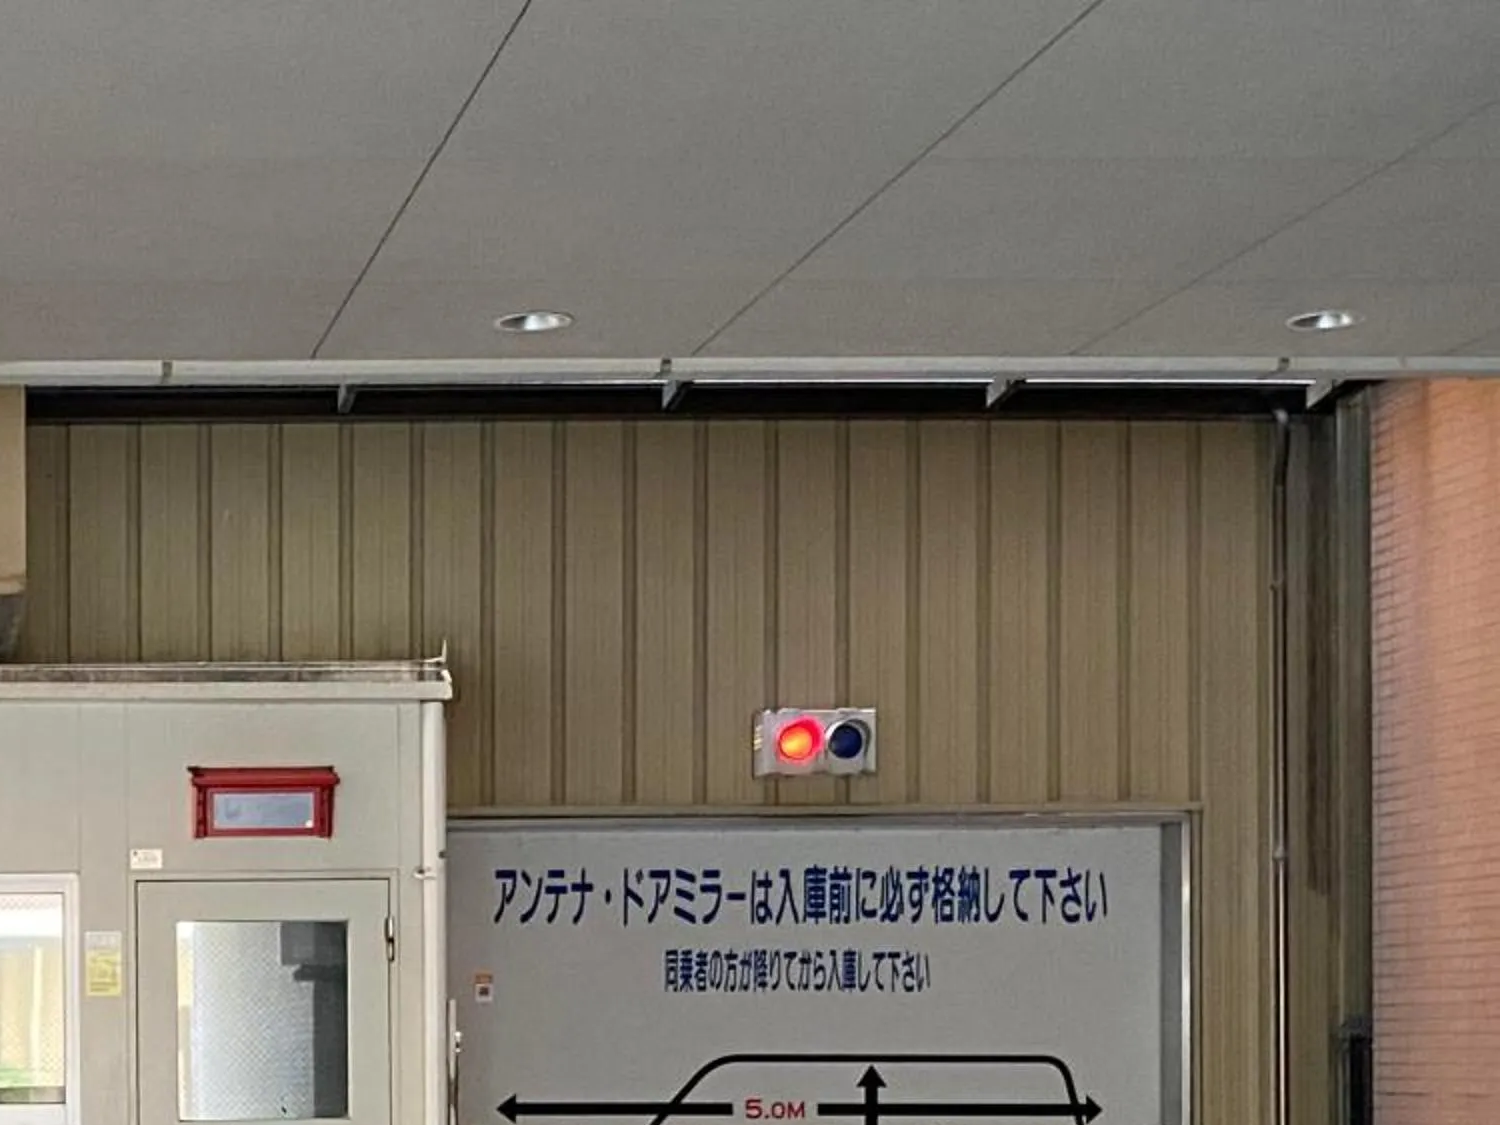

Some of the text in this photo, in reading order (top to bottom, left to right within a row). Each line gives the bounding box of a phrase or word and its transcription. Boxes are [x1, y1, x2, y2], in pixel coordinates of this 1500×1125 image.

[494, 866, 1108, 926] アンテナ・ドアミラーは入庫前に必ず格納して下さい
[665, 948, 932, 993] 同乗者の方が降りてから入庫して下さい
[745, 1098, 805, 1119] 5.0M
